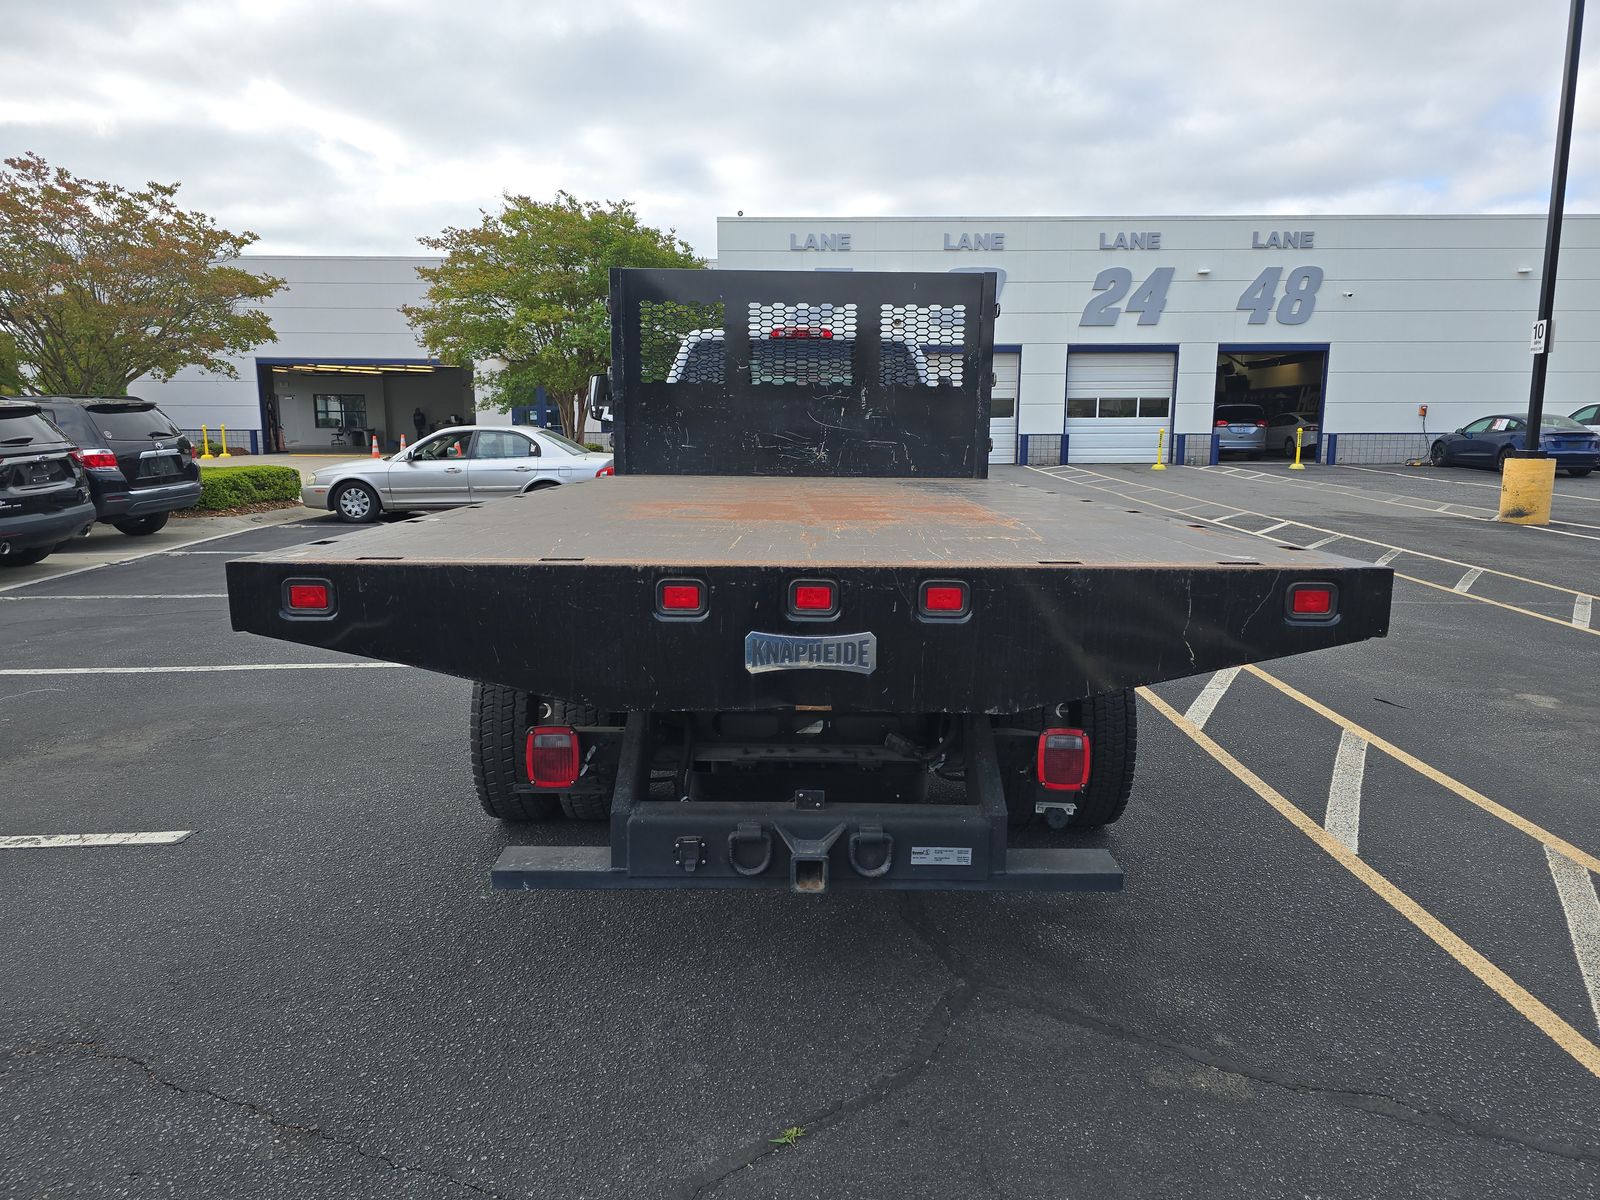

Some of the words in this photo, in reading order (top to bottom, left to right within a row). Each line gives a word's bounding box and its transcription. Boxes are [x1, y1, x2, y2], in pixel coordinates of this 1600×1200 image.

[790, 233, 851, 251] LANE
[943, 233, 1005, 251] LANE
[1099, 232, 1161, 250] LANE
[1252, 231, 1315, 249] LANE
[1079, 266, 1175, 327] 24
[1236, 265, 1324, 326] 48
[1533, 323, 1545, 340] 10
[751, 638, 870, 668] KNAPHEIDE
